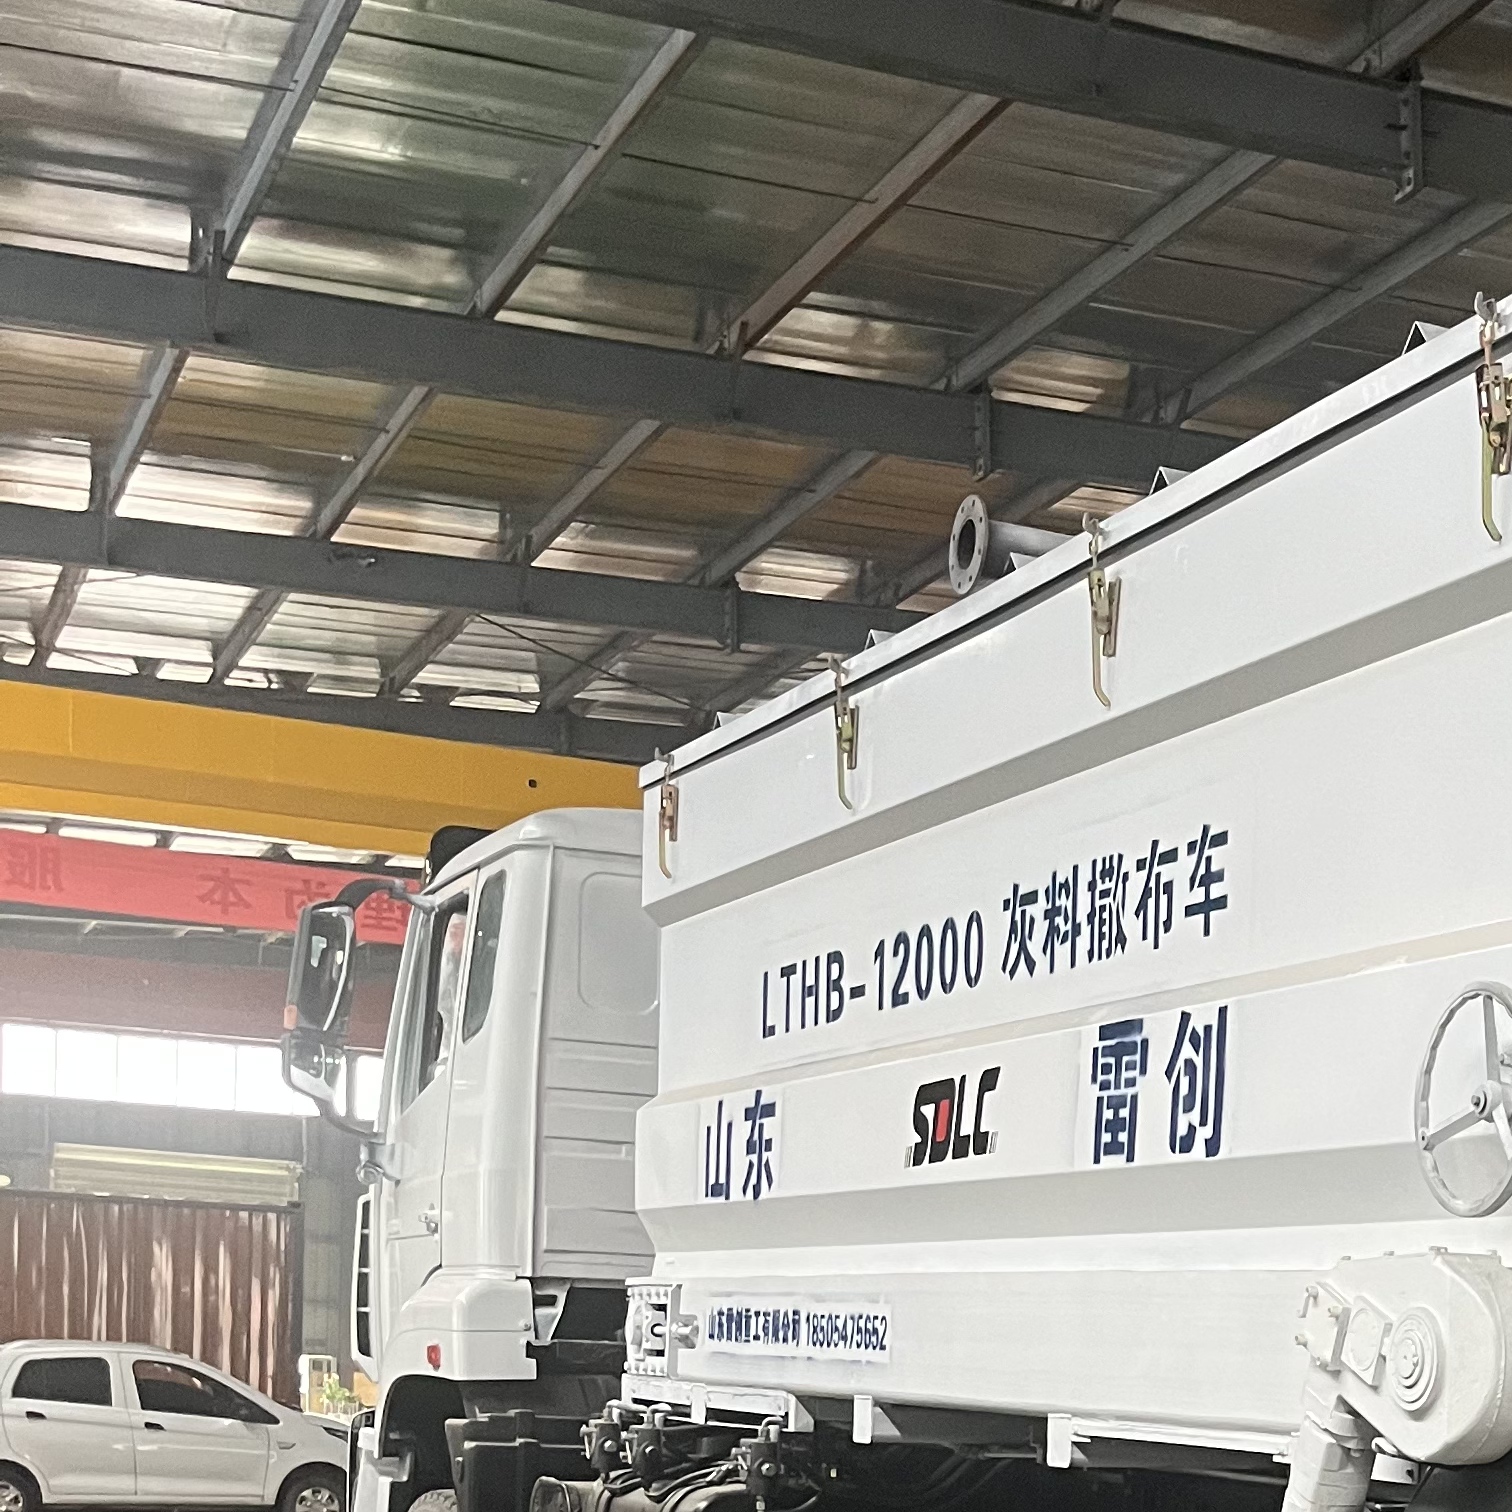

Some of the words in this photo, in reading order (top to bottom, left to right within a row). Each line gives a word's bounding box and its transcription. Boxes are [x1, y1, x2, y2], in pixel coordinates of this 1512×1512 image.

[760, 910, 985, 1040] LTHB-12000
[703, 1089, 777, 1202] 山东
[1090, 1005, 1229, 1166] 雷创
[804, 1311, 888, 1351] 18505475652
